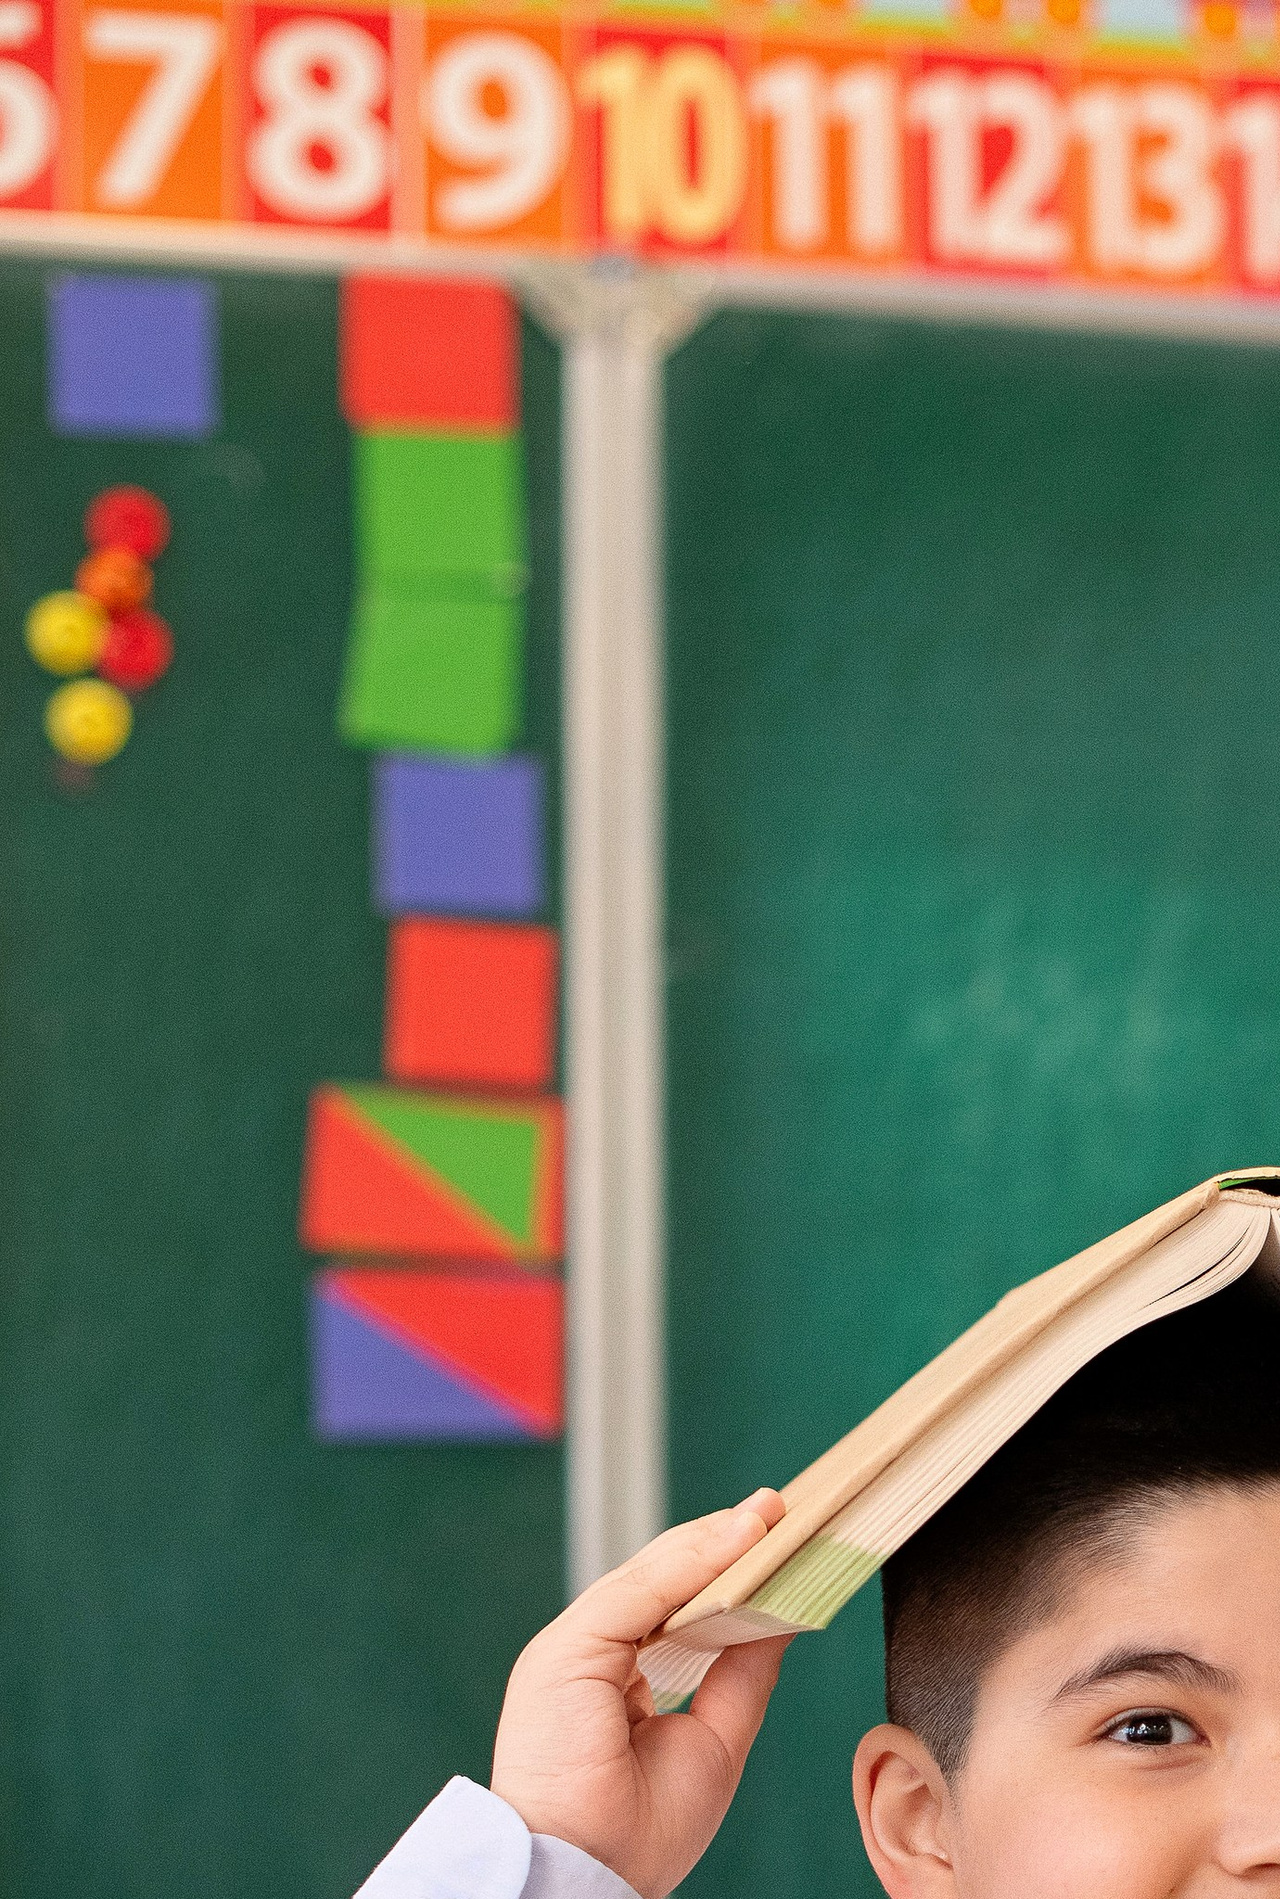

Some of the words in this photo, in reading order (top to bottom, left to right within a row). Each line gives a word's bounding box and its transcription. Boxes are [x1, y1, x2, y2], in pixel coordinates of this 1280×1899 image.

[82, 8, 216, 206] 7
[248, 17, 392, 222] 8
[428, 32, 572, 231] 9
[578, 45, 746, 243] 10
[748, 62, 908, 252] 11
[907, 67, 1066, 264] 12
[1068, 80, 1226, 276] 13
